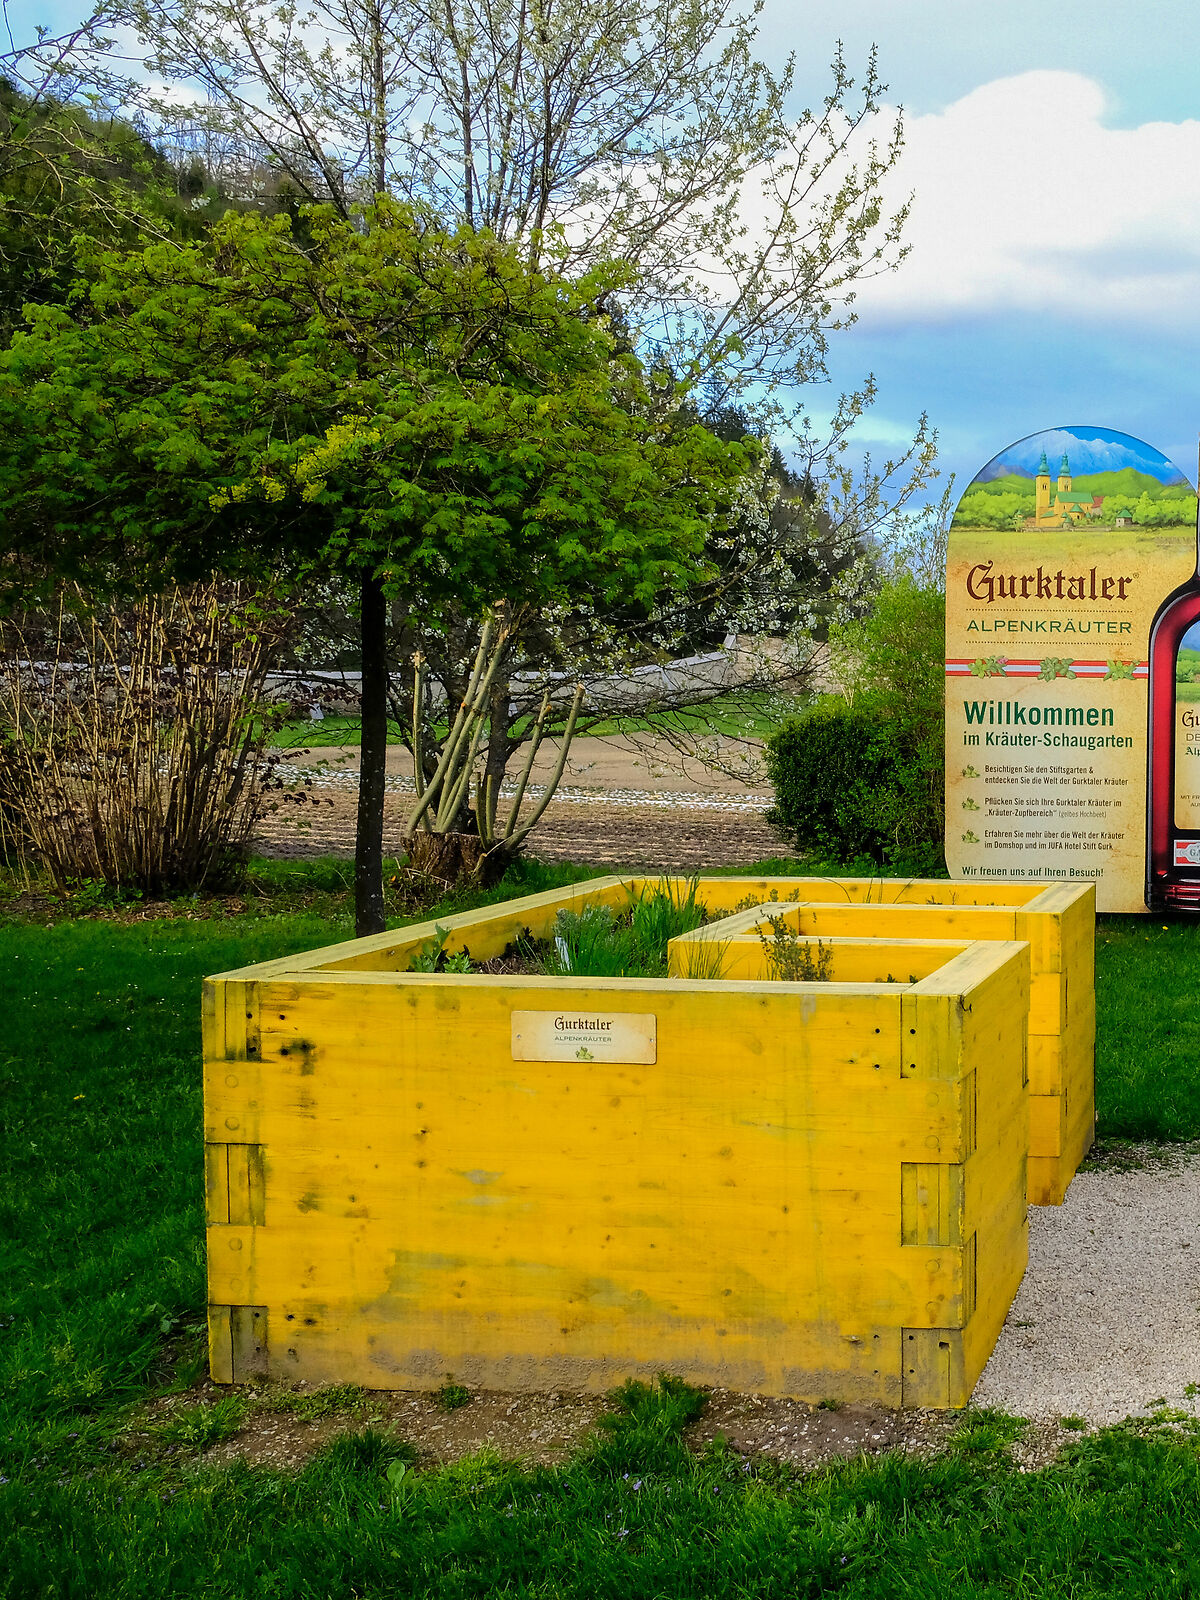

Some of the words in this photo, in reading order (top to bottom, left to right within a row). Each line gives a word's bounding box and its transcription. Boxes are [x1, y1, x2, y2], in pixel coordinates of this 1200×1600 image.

[966, 560, 1133, 604] Gurktaler
[966, 618, 1132, 634] ALPENKRÄUTER
[963, 700, 1114, 726] Willkommen
[963, 731, 980, 746] im
[986, 732, 1133, 750] Kräuter-Schaugarten
[985, 764, 1022, 774] Besichtigen
[1024, 766, 1034, 774] Sie
[1036, 766, 1048, 774] den
[1049, 766, 1087, 775] Stiftsgarten
[985, 776, 1018, 784] entdecken
[1020, 776, 1030, 784] Sie
[985, 798, 1013, 806] Pflücken
[1088, 799, 1112, 807] Kräuter
[985, 830, 1012, 838] Erfahren
[1044, 831, 1059, 839] über
[1100, 831, 1124, 839] Kräuter
[994, 841, 1023, 850] Domshop
[962, 866, 977, 875] Wir
[980, 866, 1007, 876] freuen
[1010, 868, 1025, 876] uns
[1028, 867, 1042, 876] auf
[1045, 868, 1066, 876] Ihren
[1069, 868, 1104, 877] Besuch!
[554, 1016, 612, 1031] Gurktaler
